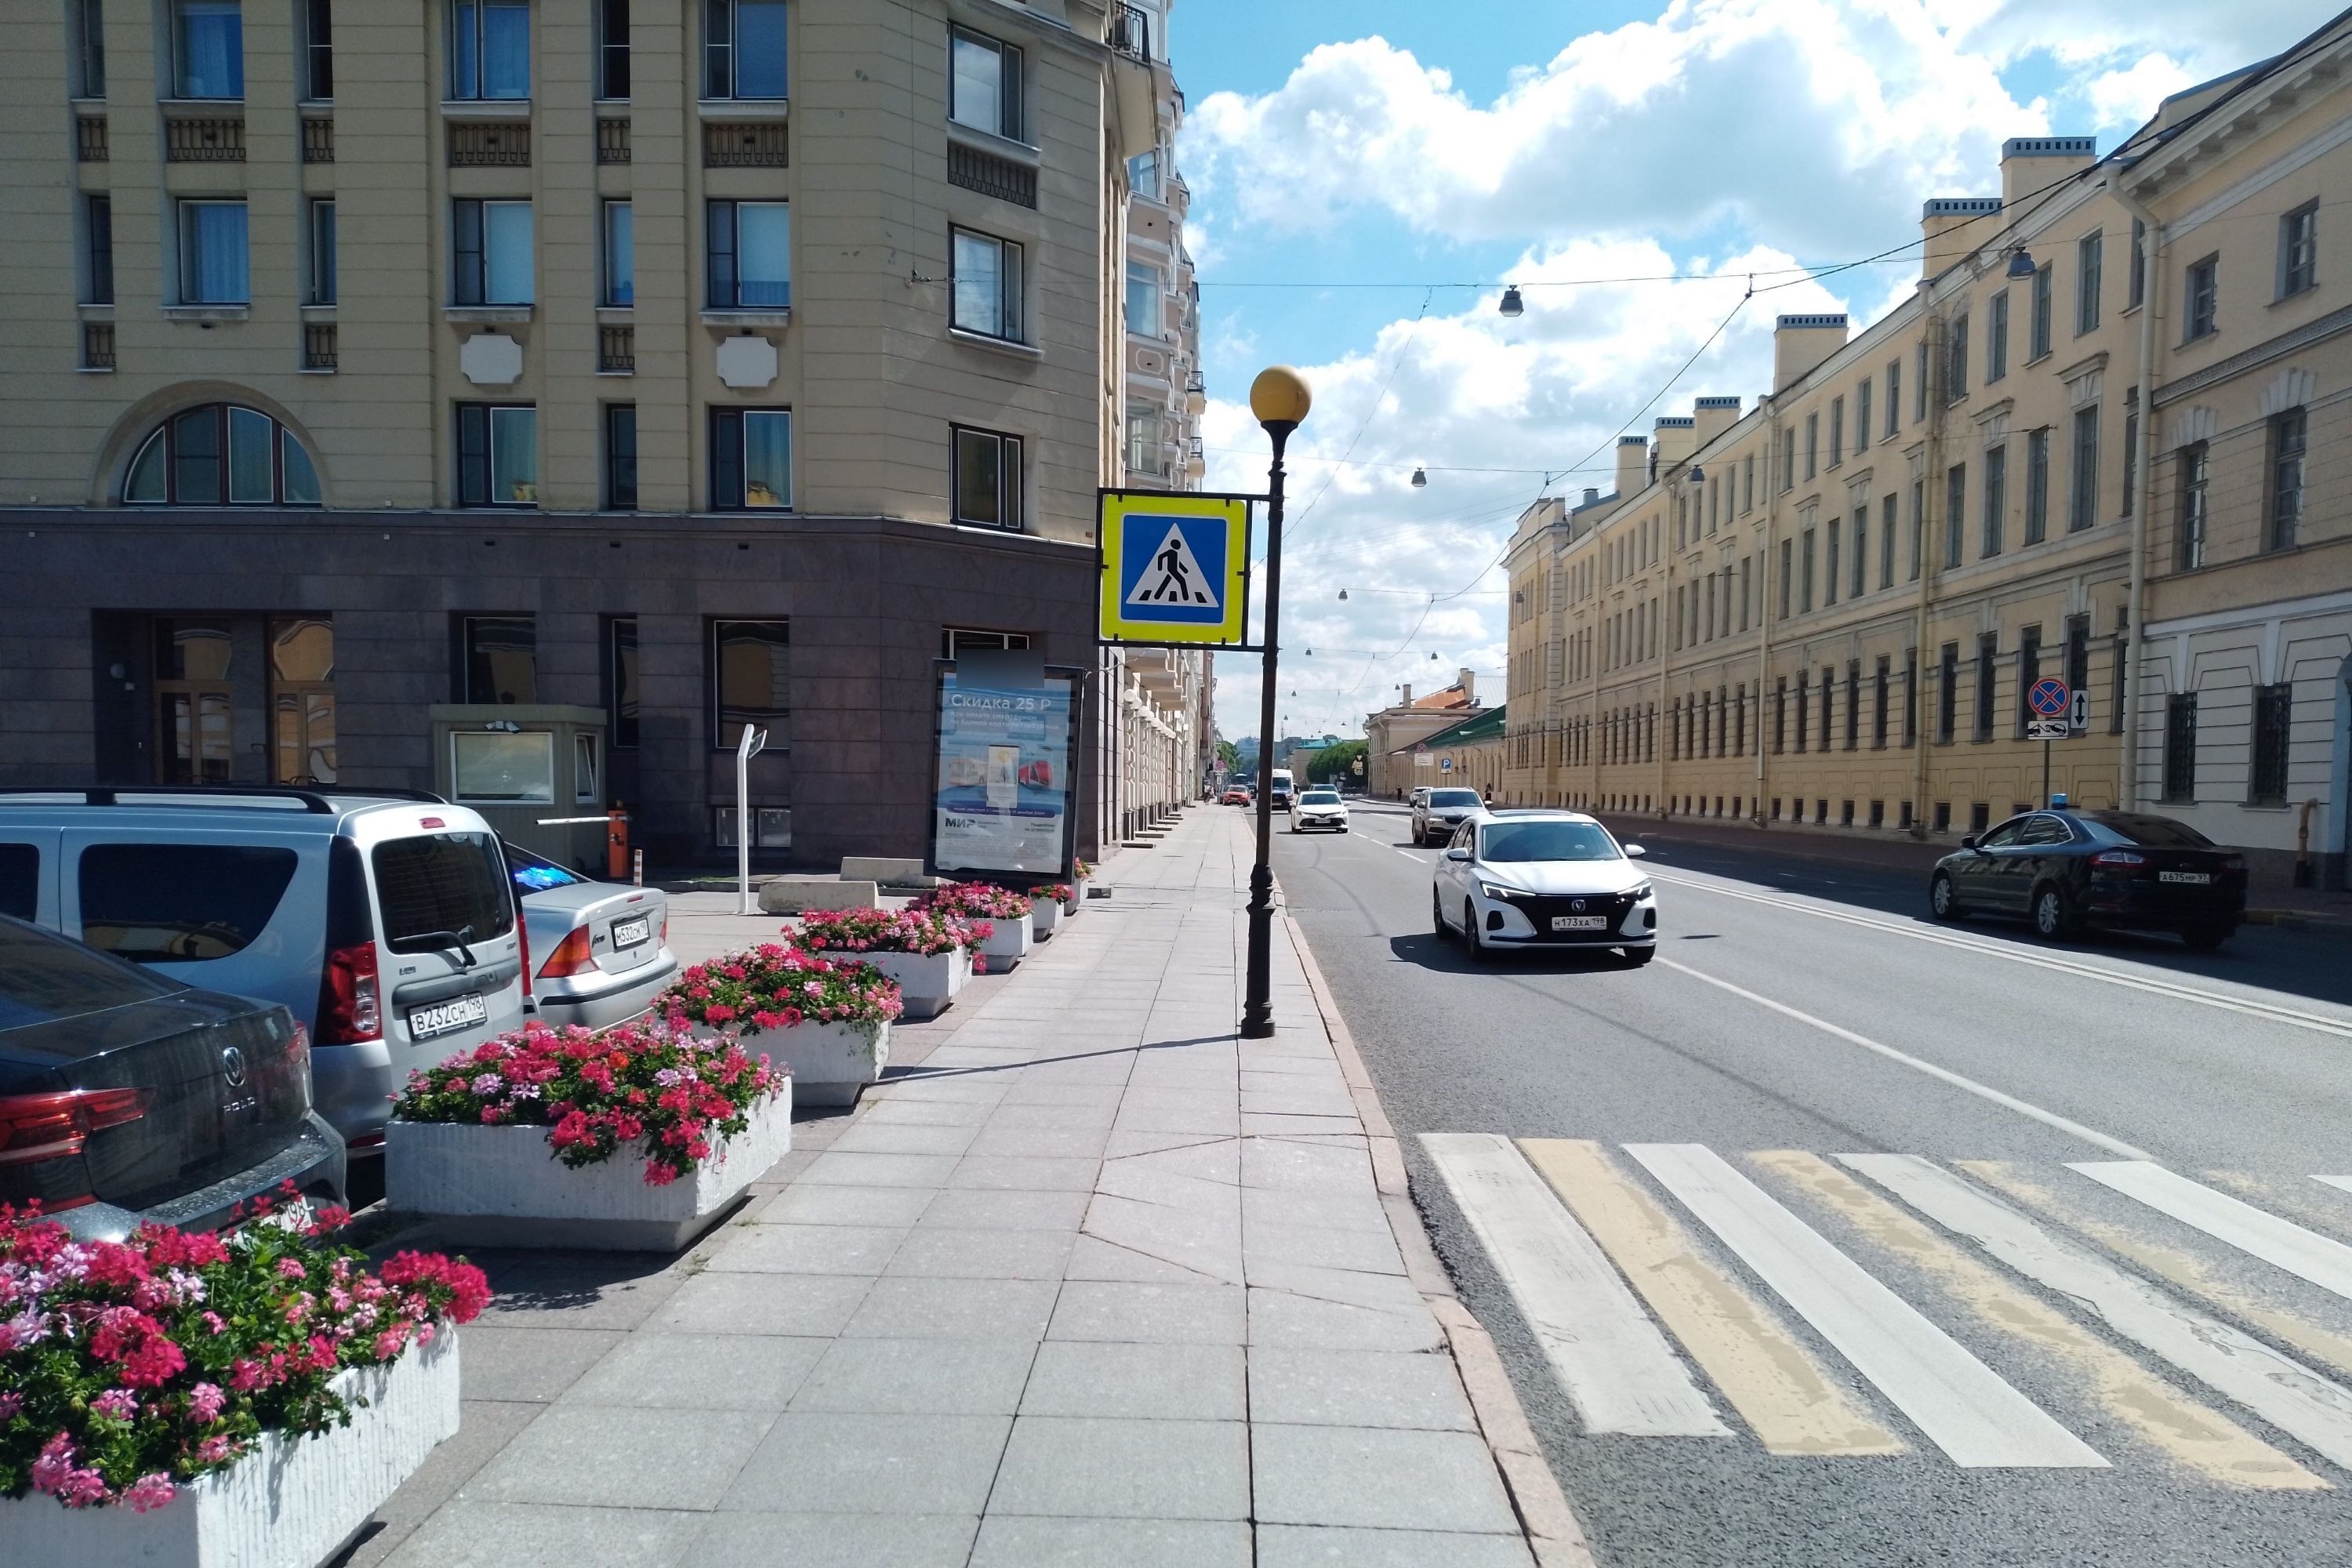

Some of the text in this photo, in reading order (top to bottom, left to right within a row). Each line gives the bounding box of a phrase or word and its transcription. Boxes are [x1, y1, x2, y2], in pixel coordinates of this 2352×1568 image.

[951, 694, 1010, 710] Скидка
[1015, 697, 1034, 710] 25
[946, 818, 976, 829] МИР
[223, 1097, 256, 1115] POLO
